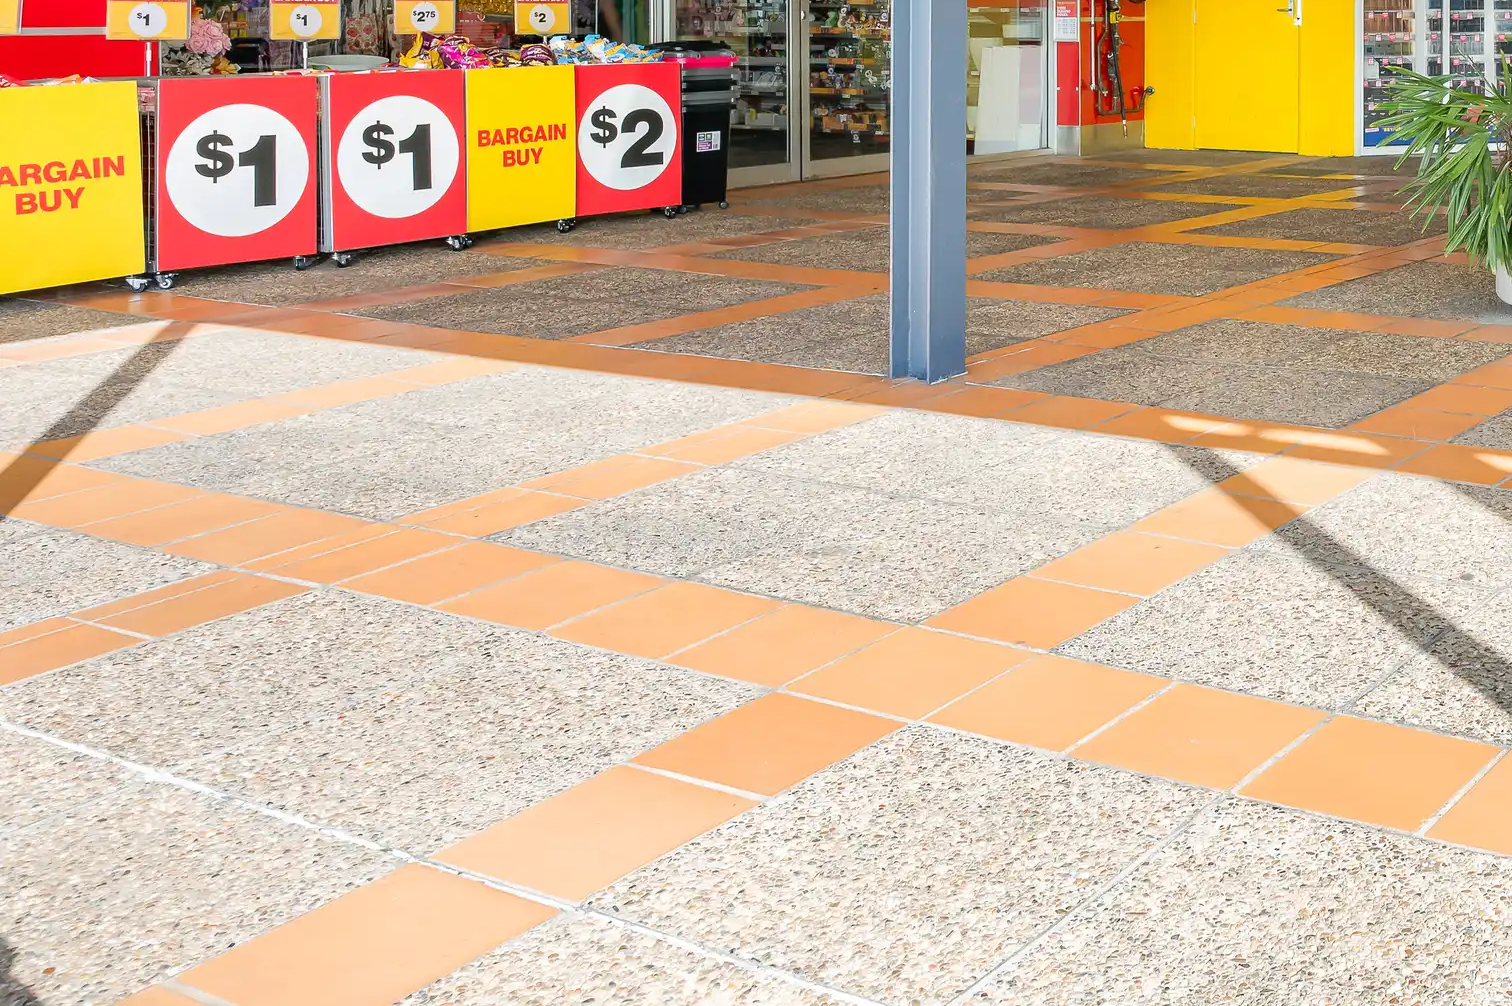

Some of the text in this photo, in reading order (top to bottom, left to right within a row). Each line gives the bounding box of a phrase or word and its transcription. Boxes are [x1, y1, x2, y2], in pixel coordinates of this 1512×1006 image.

[136, 11, 151, 27] $1
[296, 13, 309, 27] $1
[534, 12, 547, 23] $2
[477, 123, 566, 147] BARGAIN
[590, 105, 664, 169] $2
[361, 120, 432, 191] $1
[502, 147, 544, 168] BUY
[194, 129, 277, 208] $1
[15, 187, 85, 215] BUY
